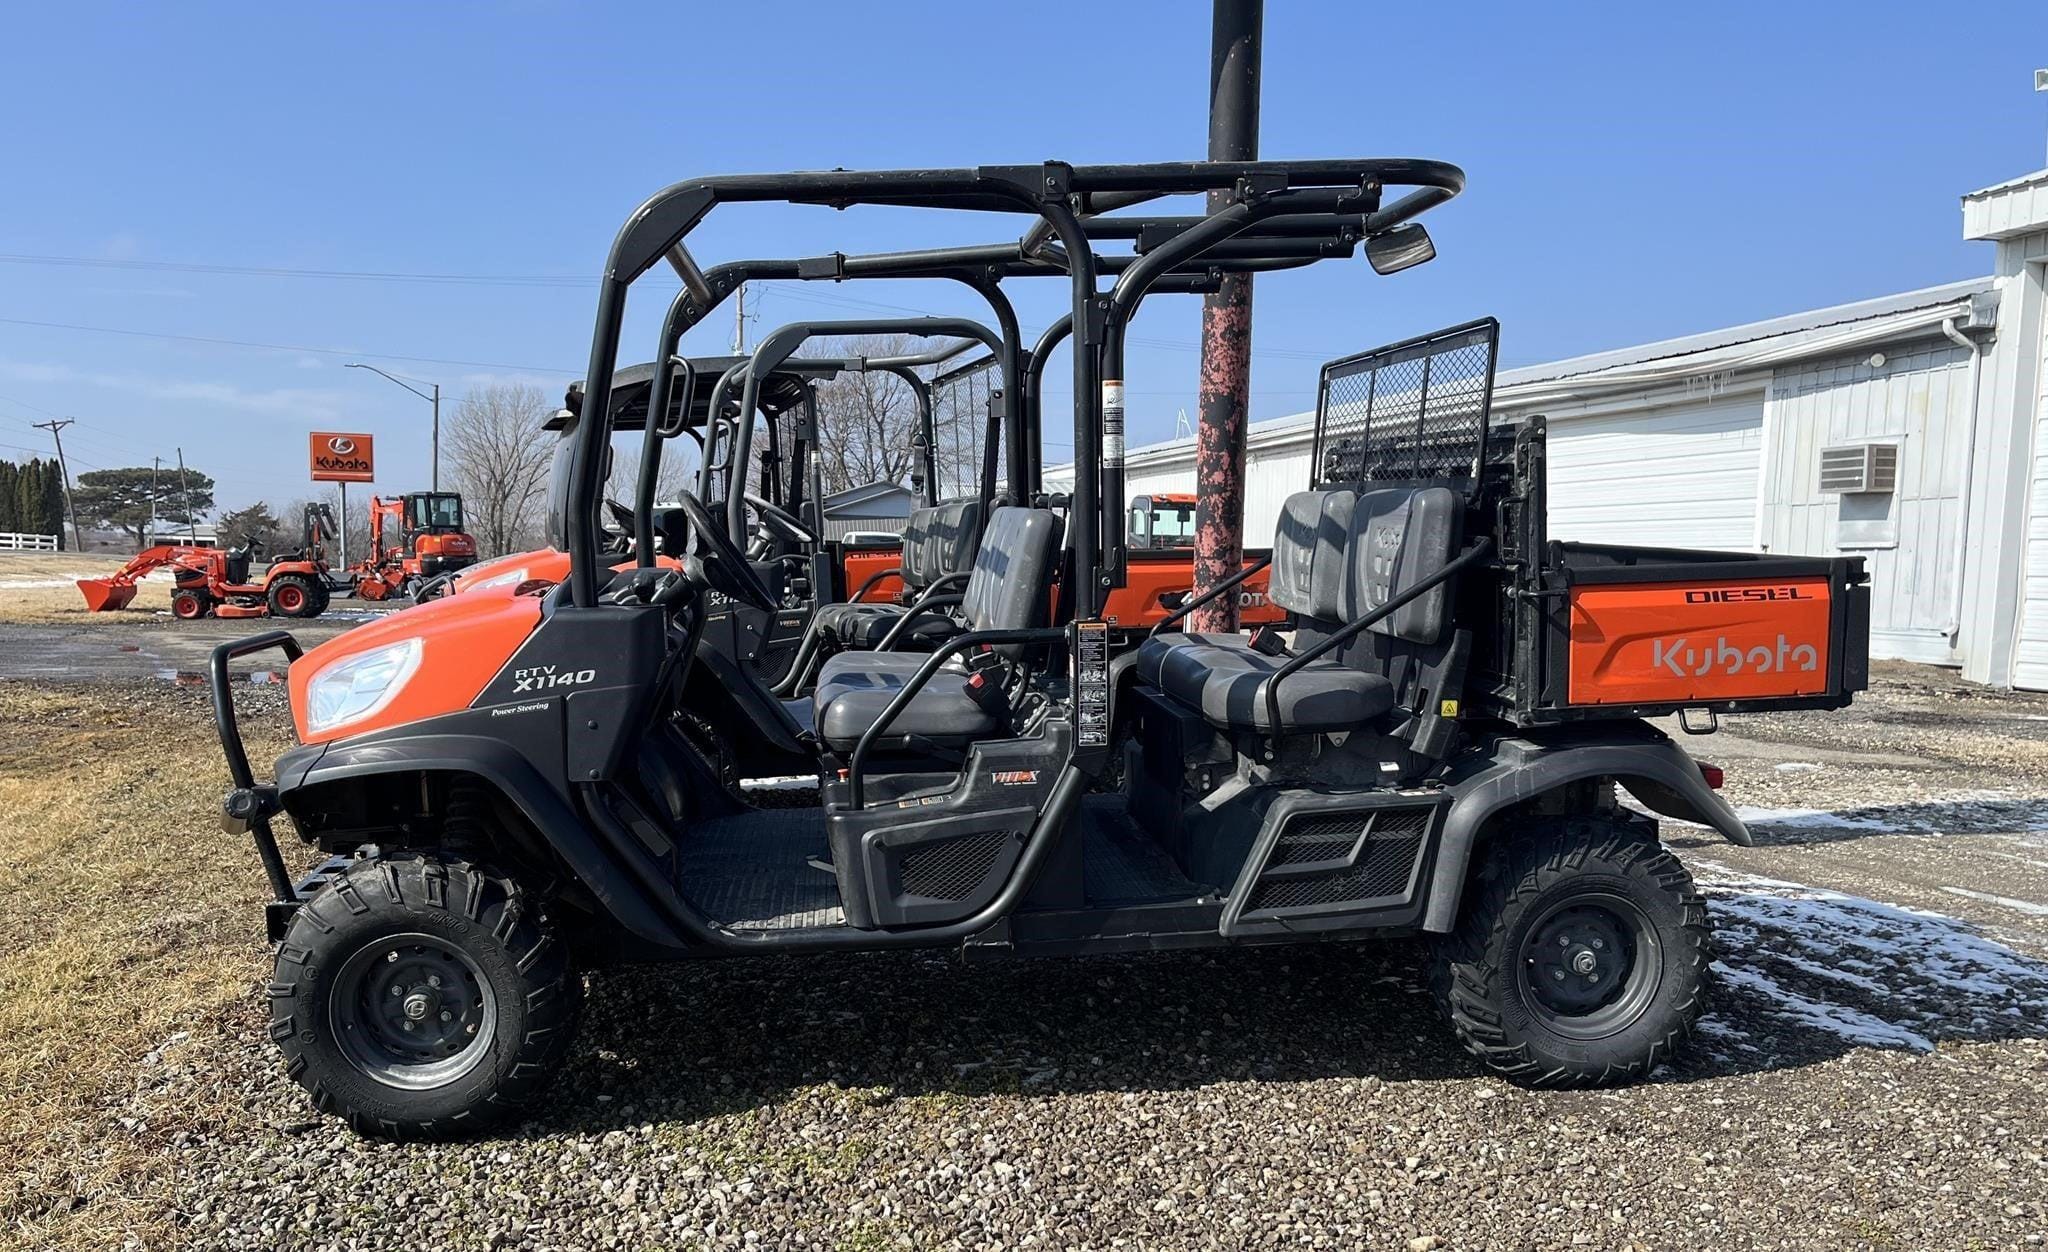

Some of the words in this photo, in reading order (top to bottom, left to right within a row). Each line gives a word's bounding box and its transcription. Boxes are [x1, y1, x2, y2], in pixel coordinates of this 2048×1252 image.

[315, 456, 369, 470] Kubota
[1685, 587, 1813, 604] DIESEL
[1653, 634, 1817, 677] Kubota
[514, 664, 557, 679] RTV
[512, 669, 596, 694] X1140
[491, 707, 517, 717] Power
[516, 702, 549, 713] Steering
